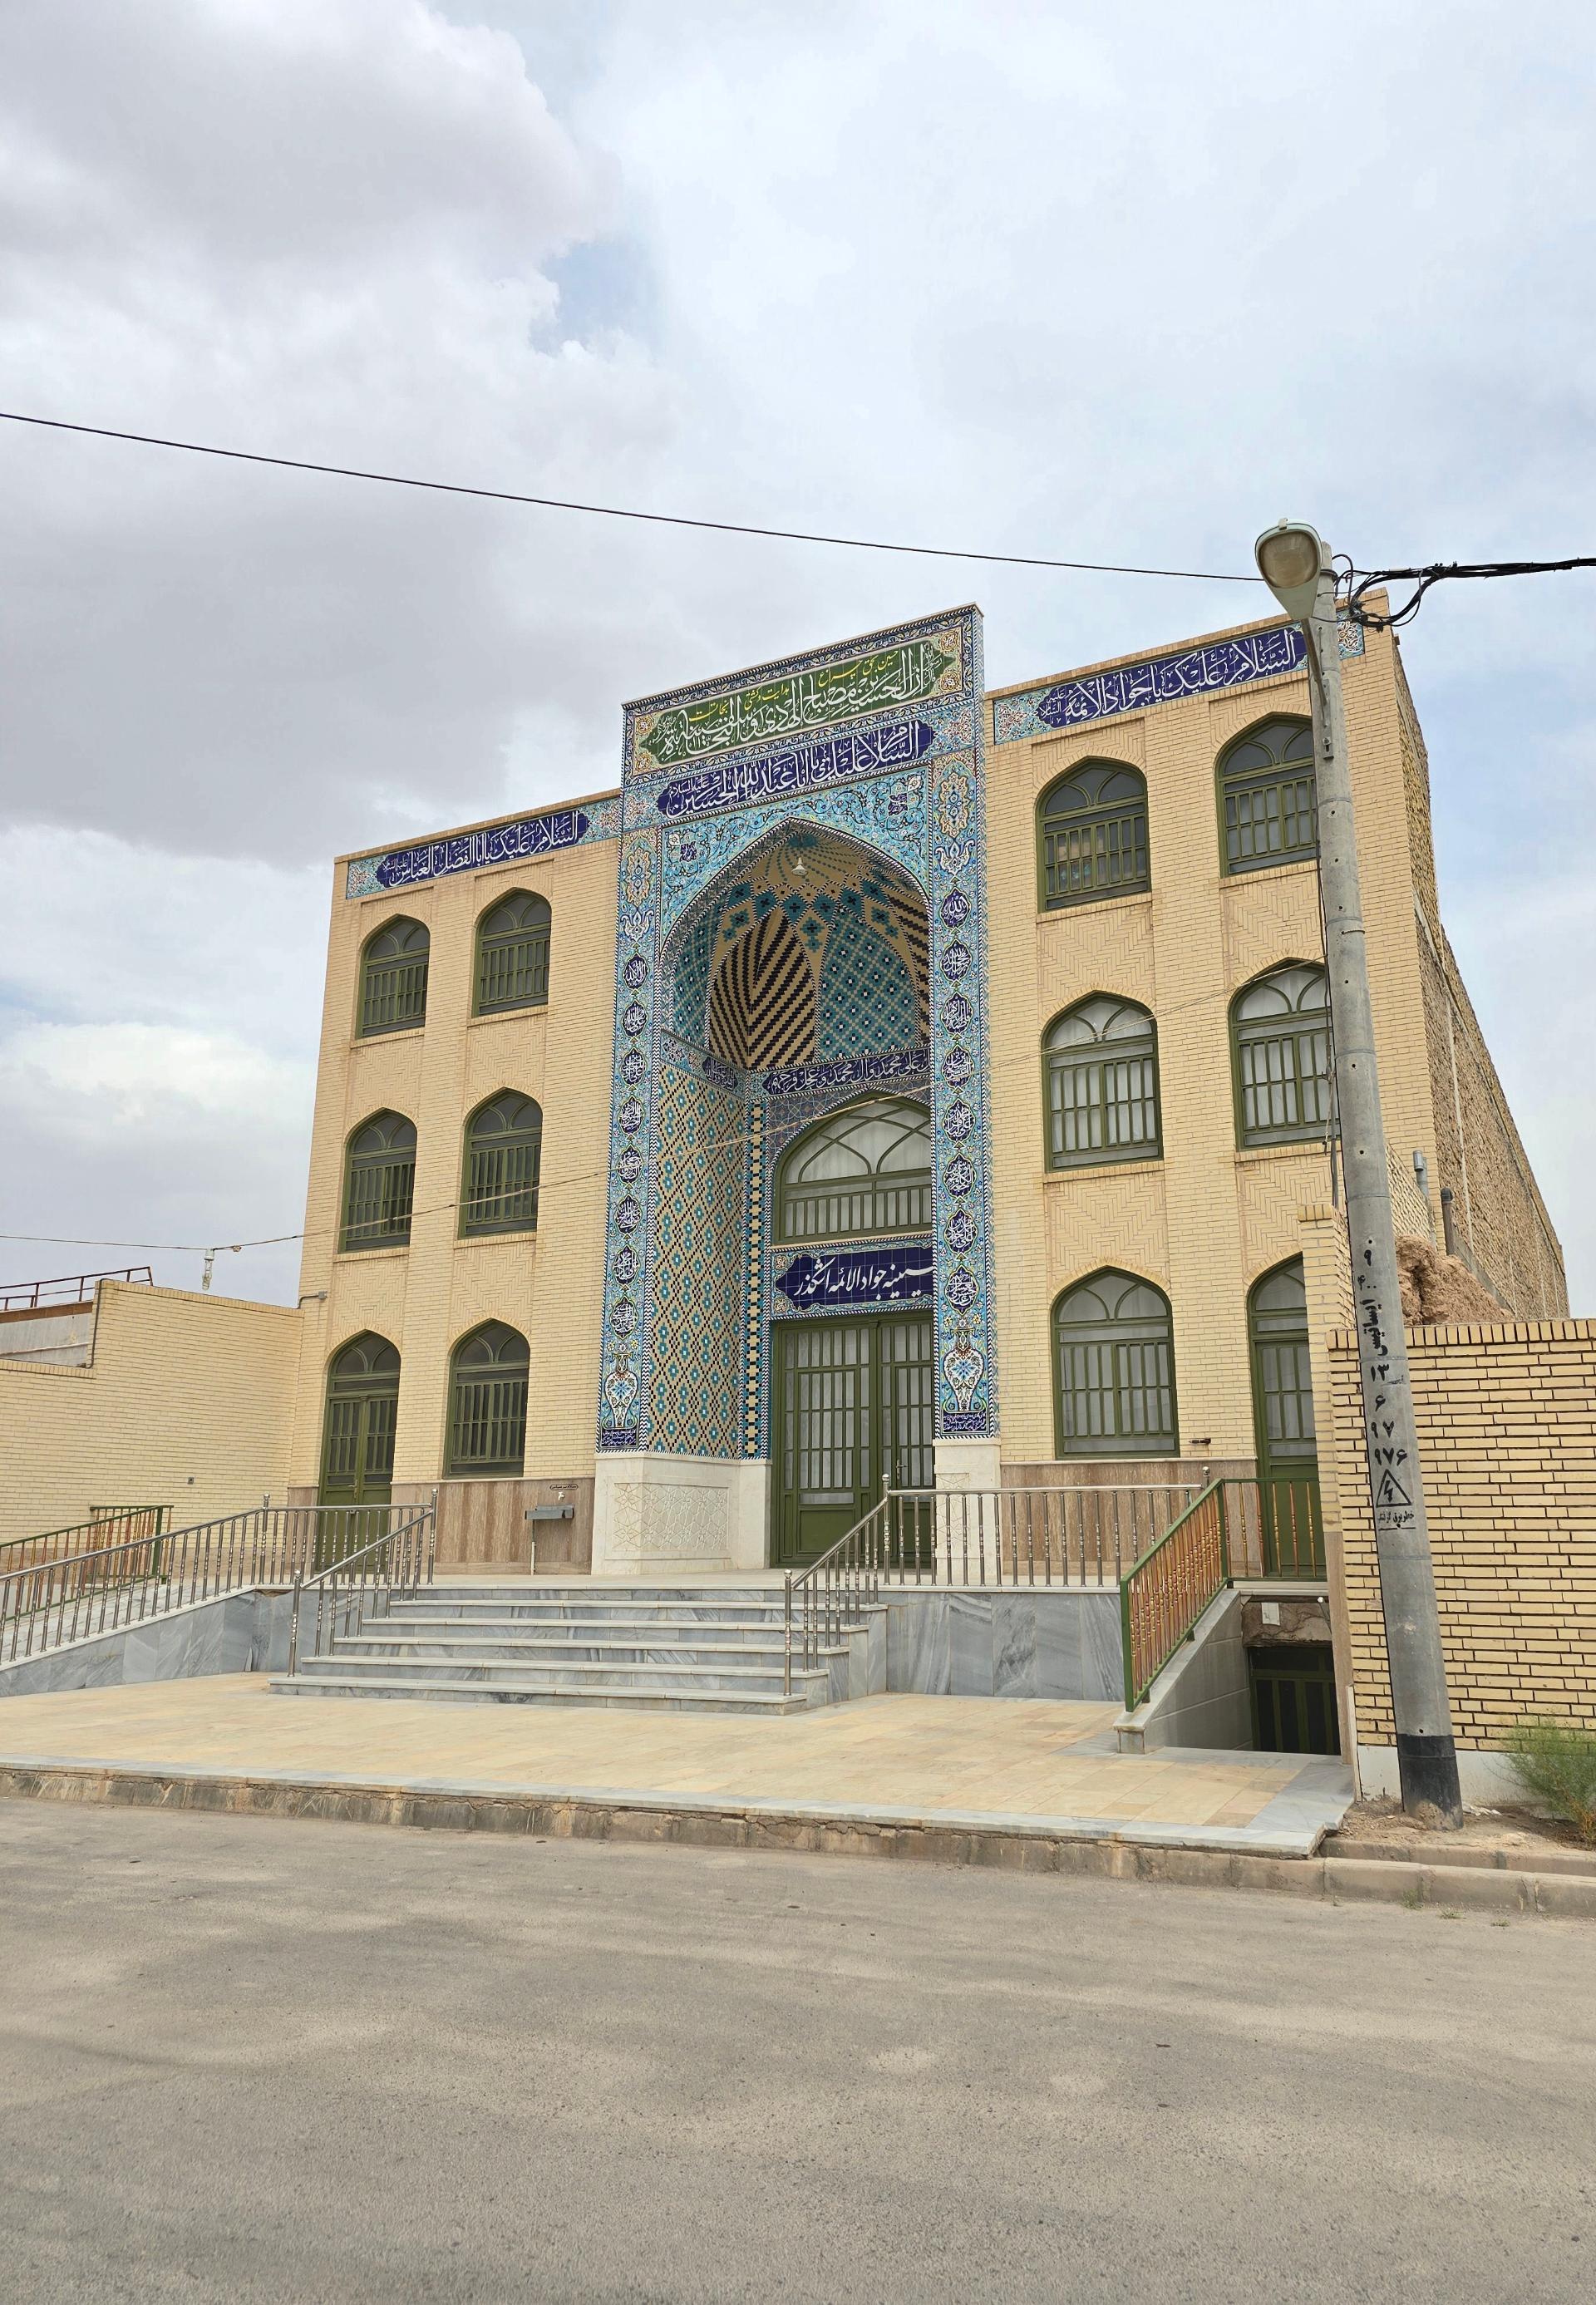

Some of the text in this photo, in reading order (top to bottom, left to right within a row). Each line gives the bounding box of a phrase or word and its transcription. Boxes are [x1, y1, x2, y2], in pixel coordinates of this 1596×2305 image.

[1370, 1363, 1390, 1382] ۱۳
[1371, 1420, 1395, 1439] ۹۷
[1374, 1446, 1408, 1466] ۹۷۶
